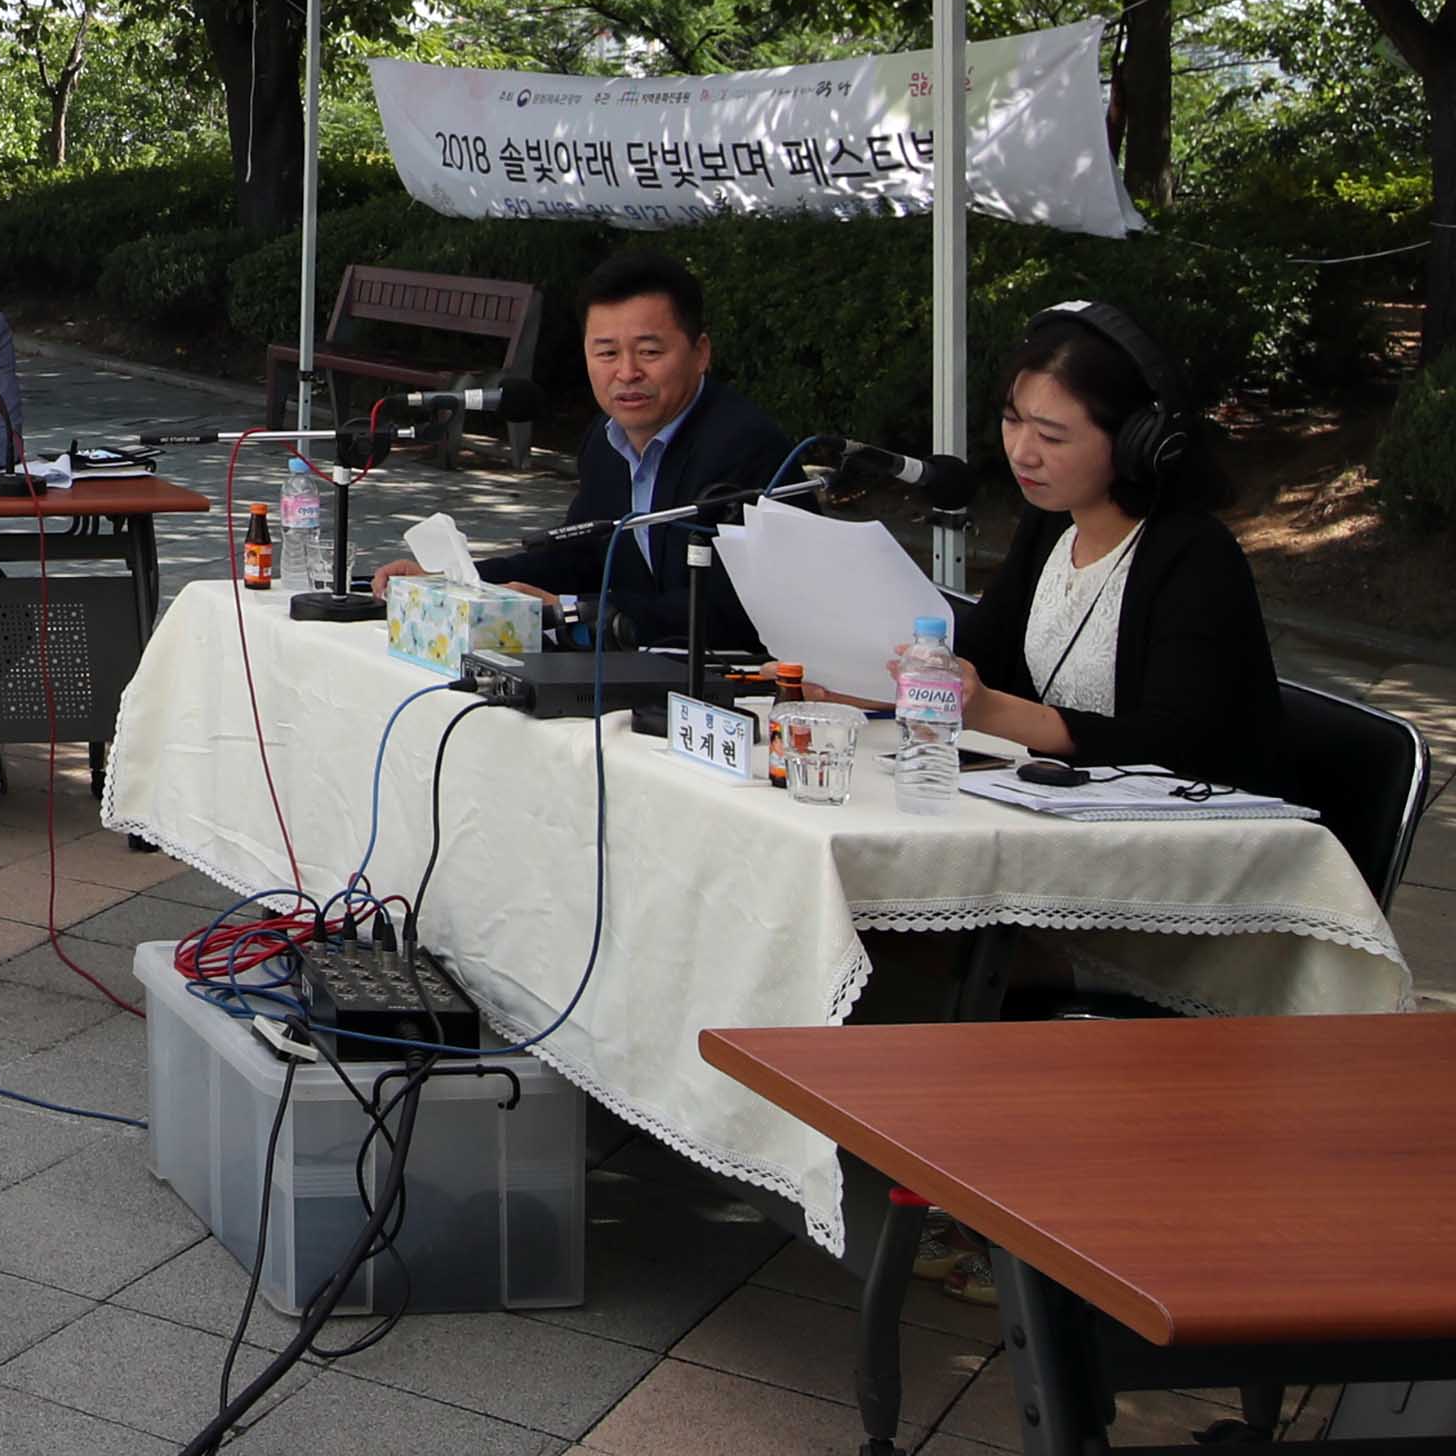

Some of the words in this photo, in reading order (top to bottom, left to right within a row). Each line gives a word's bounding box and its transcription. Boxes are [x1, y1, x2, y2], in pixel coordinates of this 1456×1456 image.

[435, 130, 491, 175] 2018
[499, 136, 619, 188] 솔빛아래
[626, 138, 775, 190] 달빛보며
[679, 725, 737, 767] 권계현
